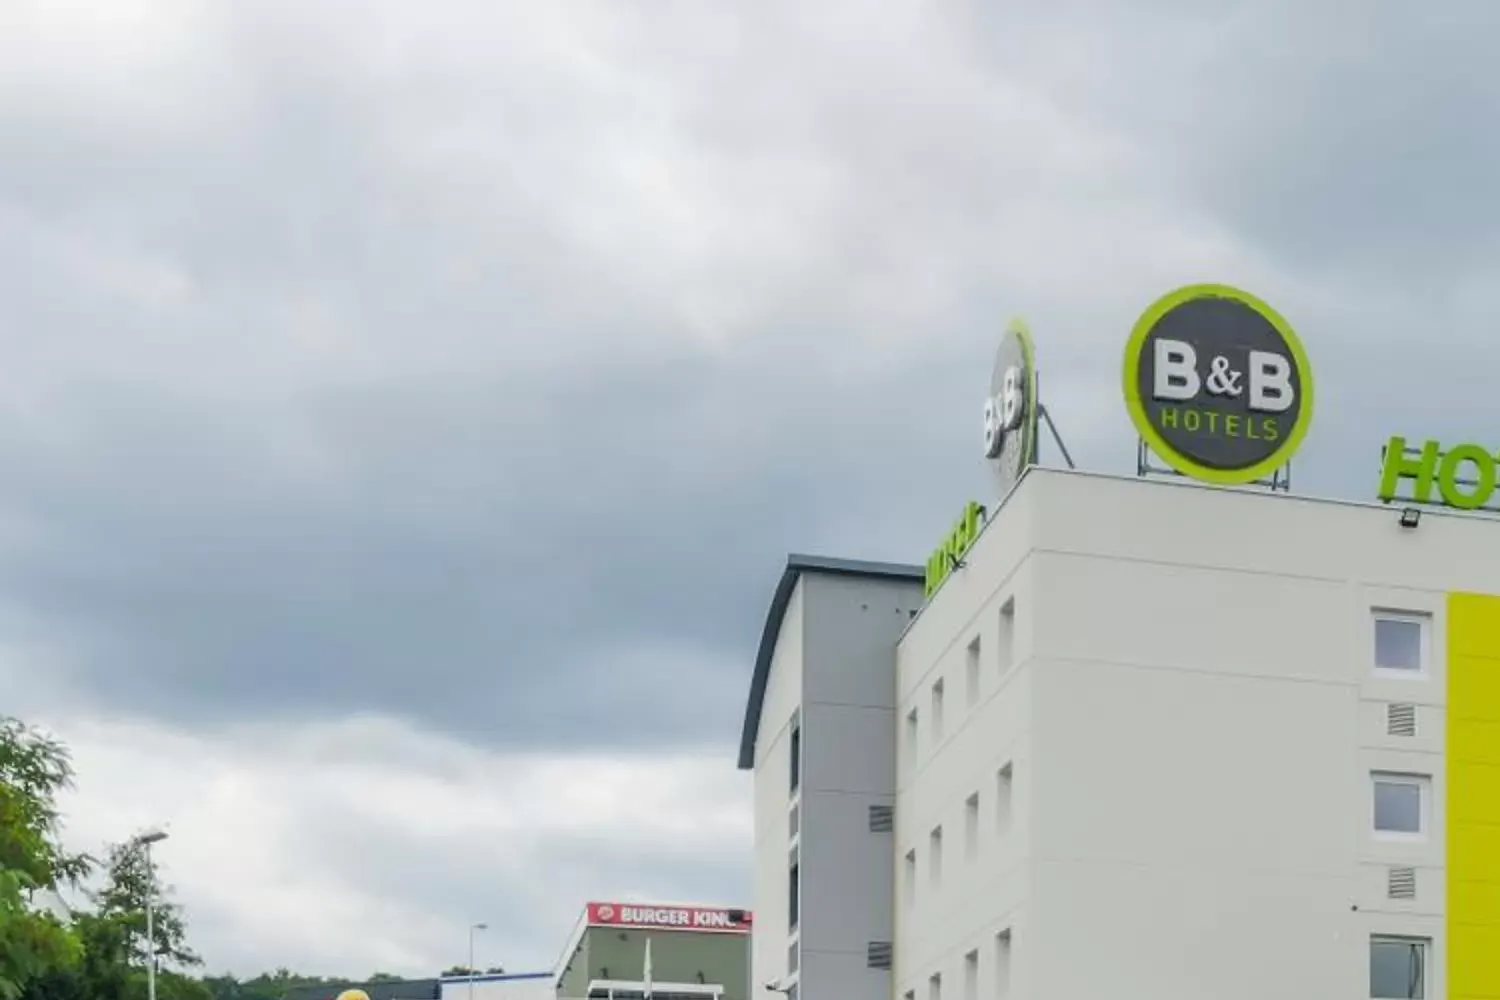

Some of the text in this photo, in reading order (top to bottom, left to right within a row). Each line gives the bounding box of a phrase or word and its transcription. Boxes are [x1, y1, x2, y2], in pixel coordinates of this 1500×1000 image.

[1154, 338, 1294, 411] B&B
[1161, 408, 1278, 440] HOTELS
[621, 907, 688, 925] BURGER
